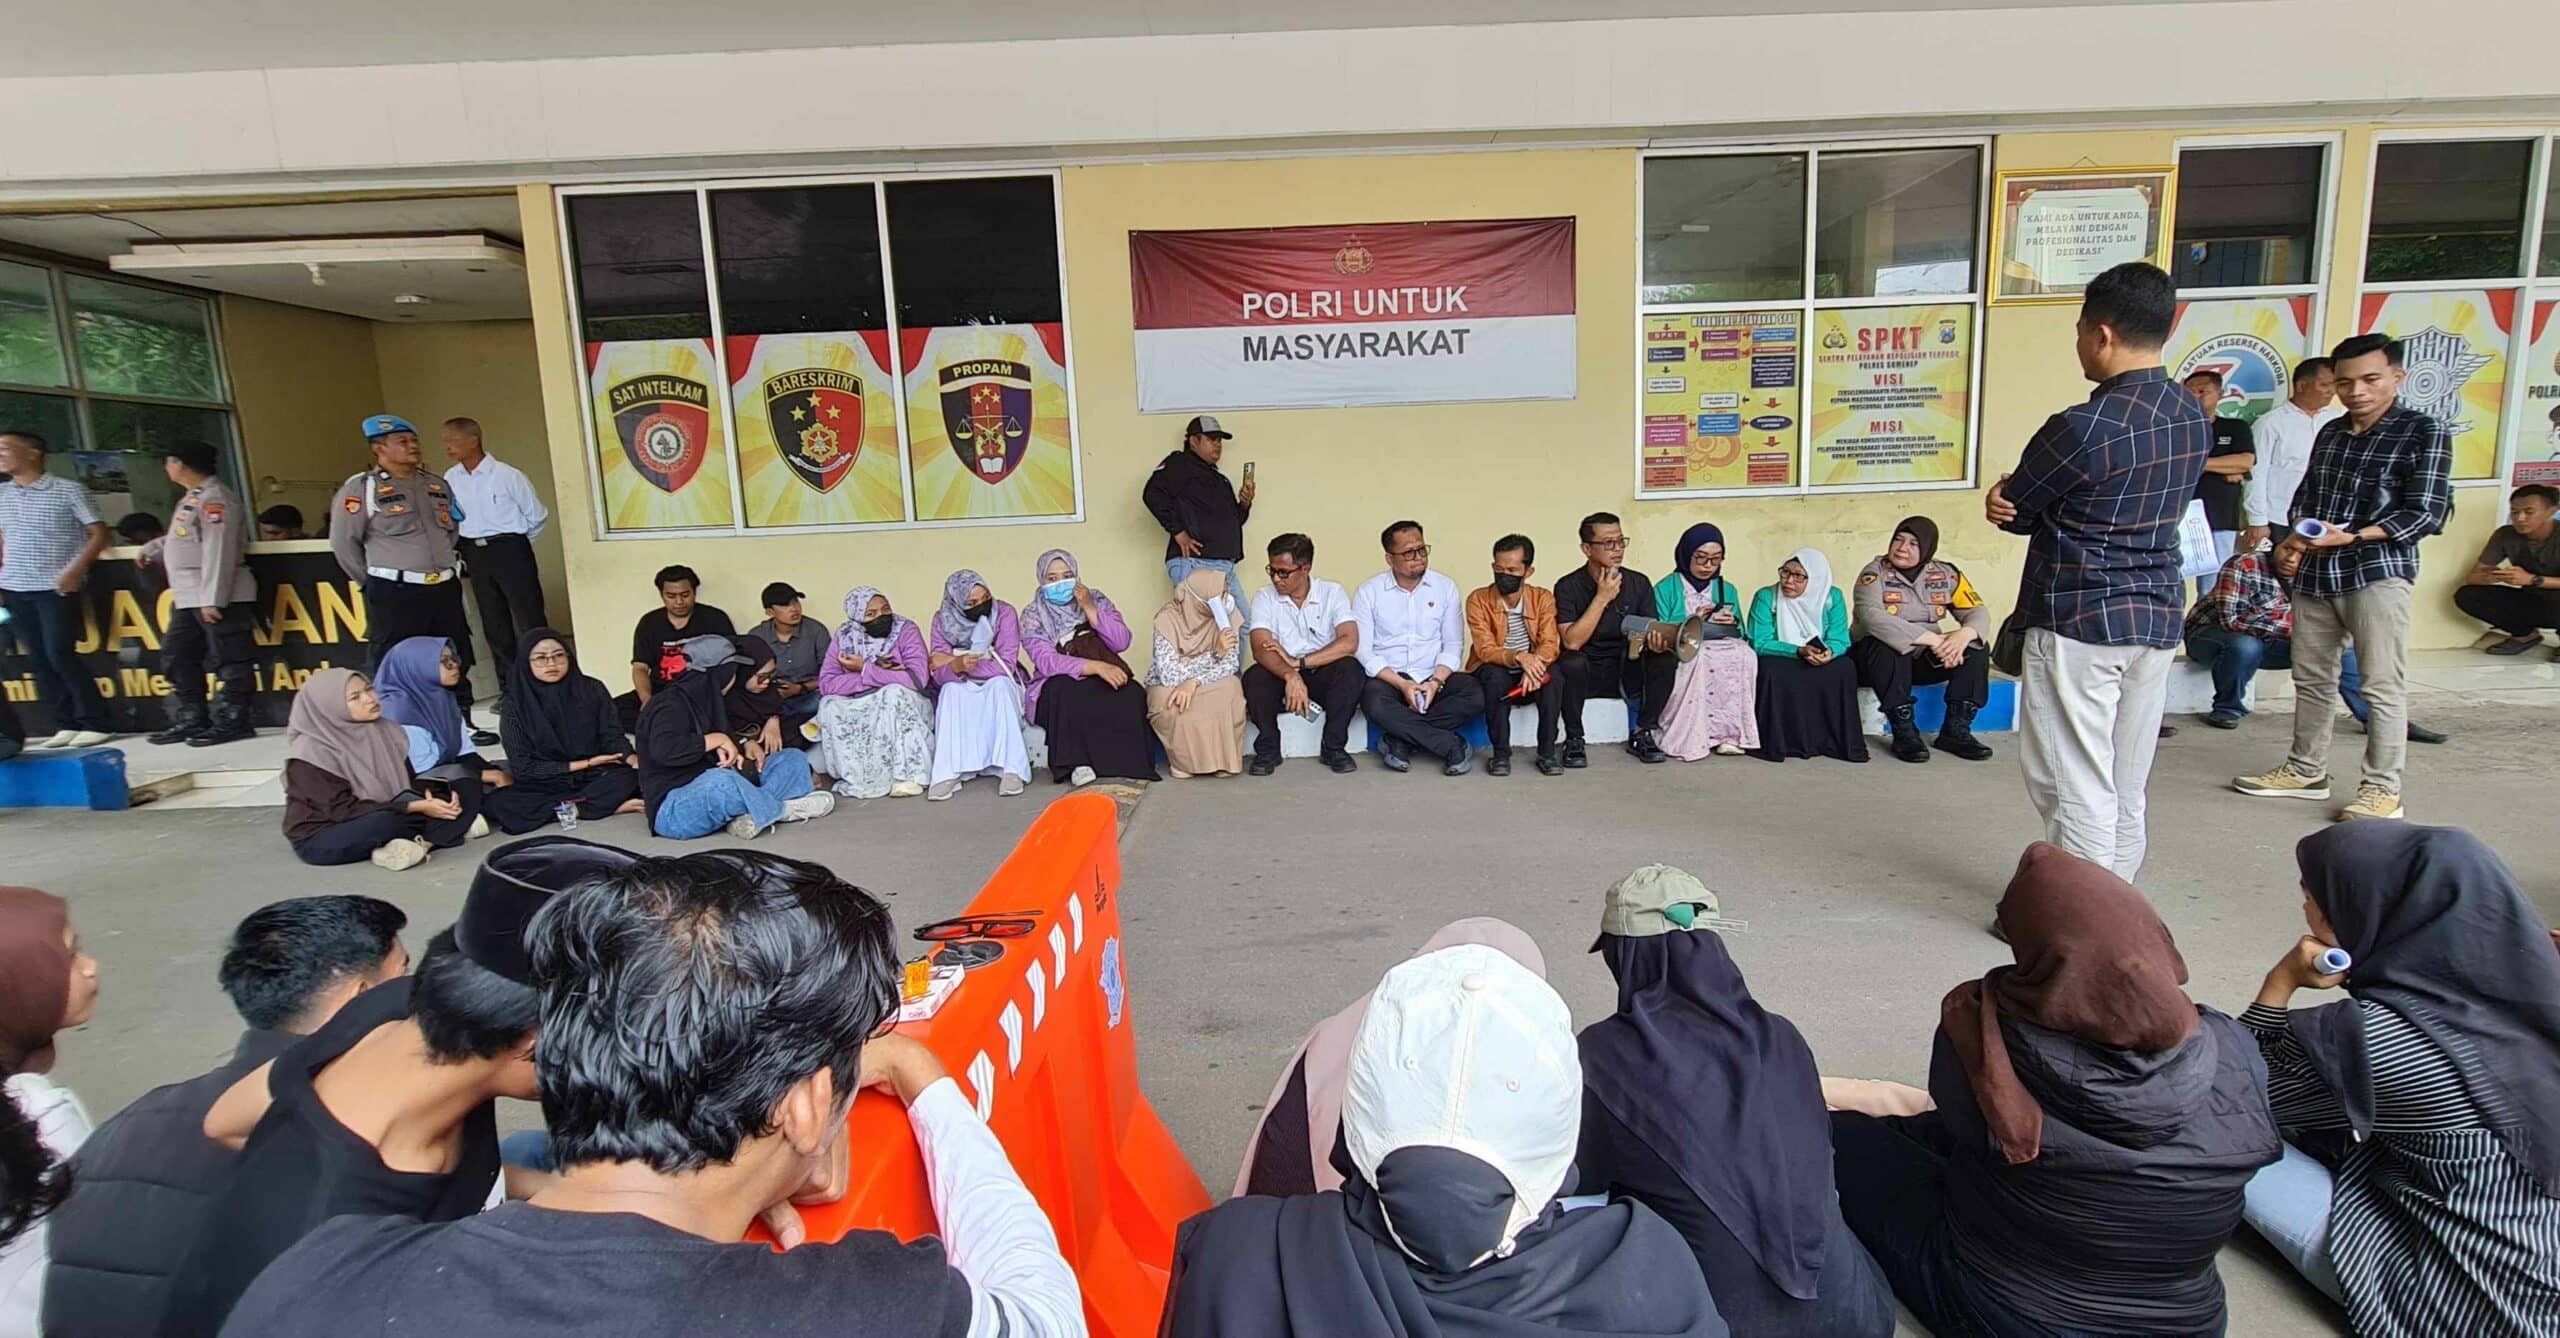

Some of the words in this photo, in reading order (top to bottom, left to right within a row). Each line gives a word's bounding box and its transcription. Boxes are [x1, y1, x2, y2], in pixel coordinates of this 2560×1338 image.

[2078, 212, 2110, 221] UNTUK
[2112, 211, 2144, 220] ANDA,
[2036, 224, 2086, 234] MELAYANI
[2088, 223, 2129, 232] DENGAN
[2025, 235, 2113, 246] PROFESIONALITAS
[2116, 234, 2137, 243] DAN
[1242, 290, 1343, 320] POLRI
[1353, 286, 1469, 317] UNTUK
[1242, 329, 1471, 363] MASYARAKAT
[1857, 327, 1922, 352] SPKT
[2183, 344, 2215, 374] SATUAN
[2217, 338, 2257, 350] RESERSE
[2258, 347, 2285, 386] NARKOBA
[952, 363, 1013, 378] PROPAM
[771, 372, 854, 395] BARESKRIM
[1873, 373, 1904, 386] VISI
[613, 385, 638, 405] SAT
[639, 380, 703, 401] INTELKAM
[2528, 385, 2560, 399] POLR
[1870, 420, 1903, 433] MISI
[1924, 581, 1949, 590] POLRI
